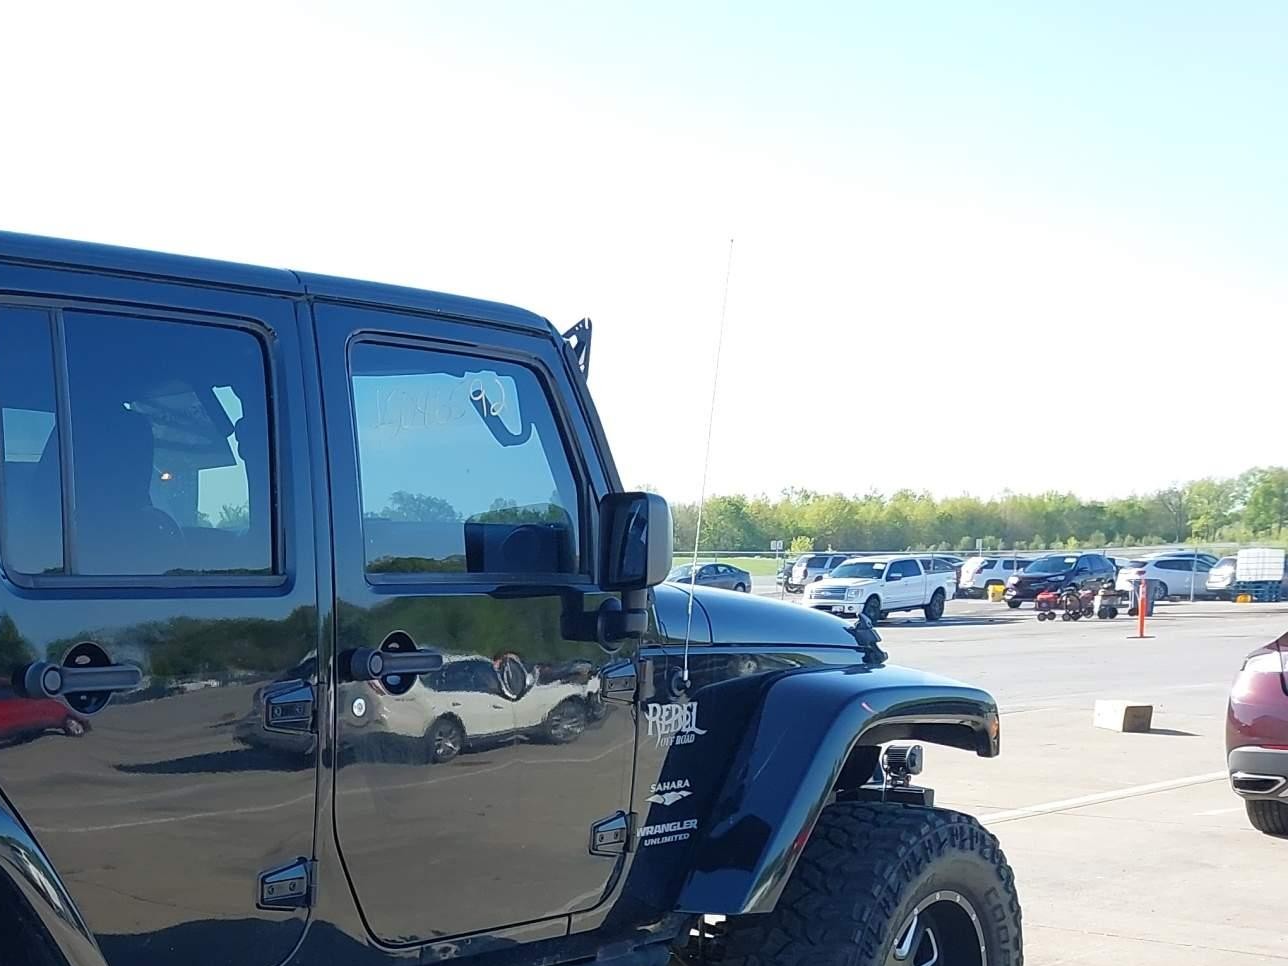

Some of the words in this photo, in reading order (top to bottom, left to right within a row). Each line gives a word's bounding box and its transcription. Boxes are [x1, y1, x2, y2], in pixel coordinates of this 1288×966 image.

[644, 701, 708, 748] REBEL
[675, 734, 696, 745] ROAD
[650, 779, 690, 792] SAHARA
[637, 819, 698, 837] WRANGLER
[644, 833, 690, 846] UNLIMITED
